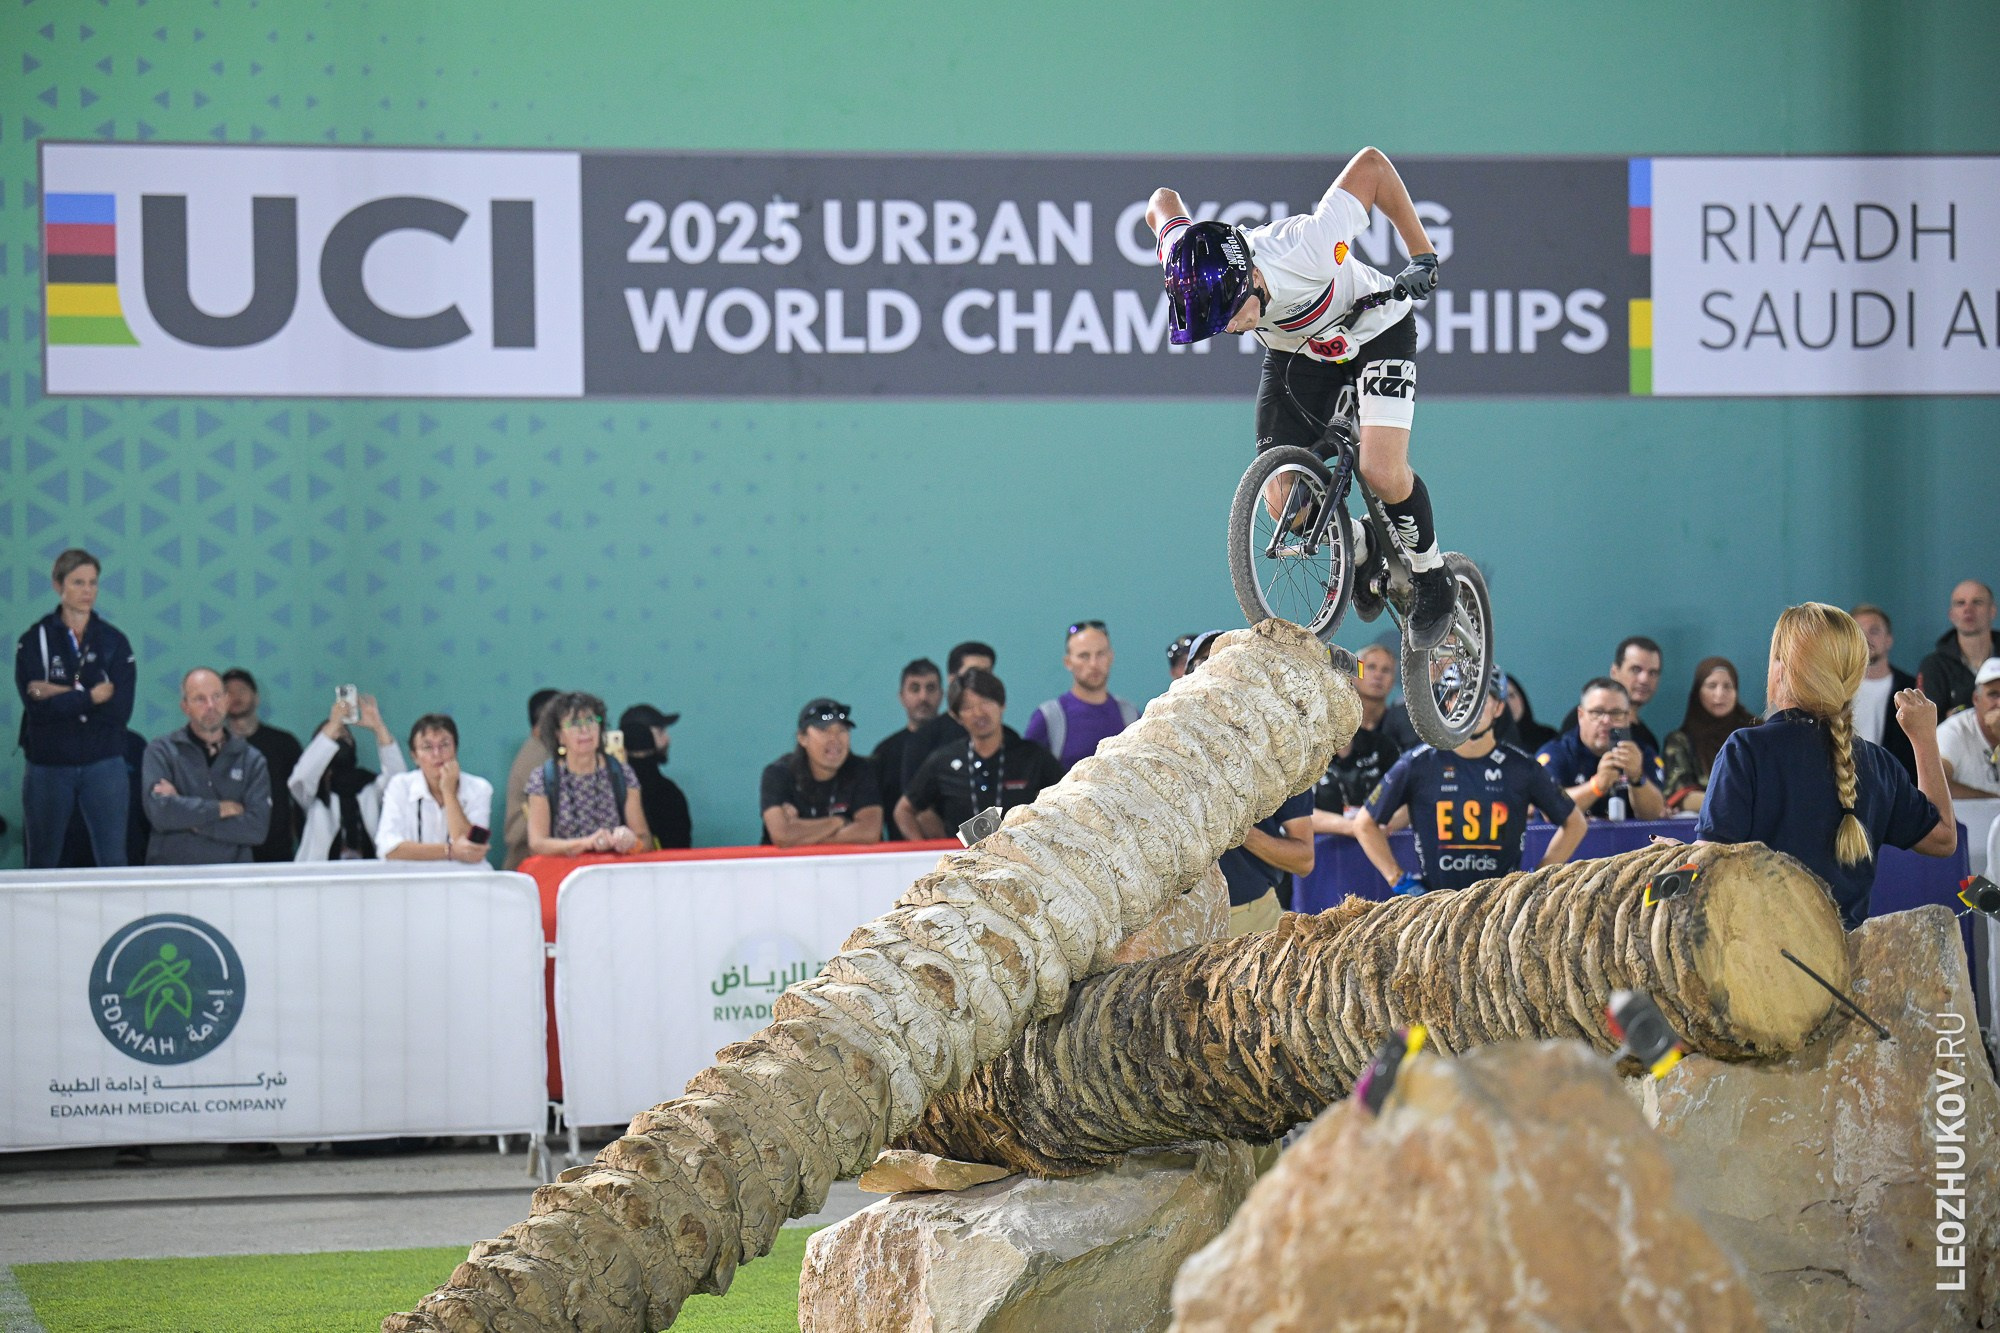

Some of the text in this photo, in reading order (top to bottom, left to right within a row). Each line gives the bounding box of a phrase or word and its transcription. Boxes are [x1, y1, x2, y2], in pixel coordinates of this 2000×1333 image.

[625, 200, 802, 264] 2025
[823, 200, 1092, 264] URBAN
[1701, 203, 1957, 262] RIYADH
[141, 194, 537, 350] UCI
[624, 287, 1609, 354] WORLD CHAMHIPS
[1700, 290, 2000, 351] SAUDI A
[1436, 800, 1508, 841] ESP
[101, 994, 175, 1055] EDAMAH
[713, 1004, 773, 1021] RIYAD
[49, 1077, 100, 1098] الطبية
[50, 1098, 287, 1118] EDAMAH MEDICAL COMPANY
